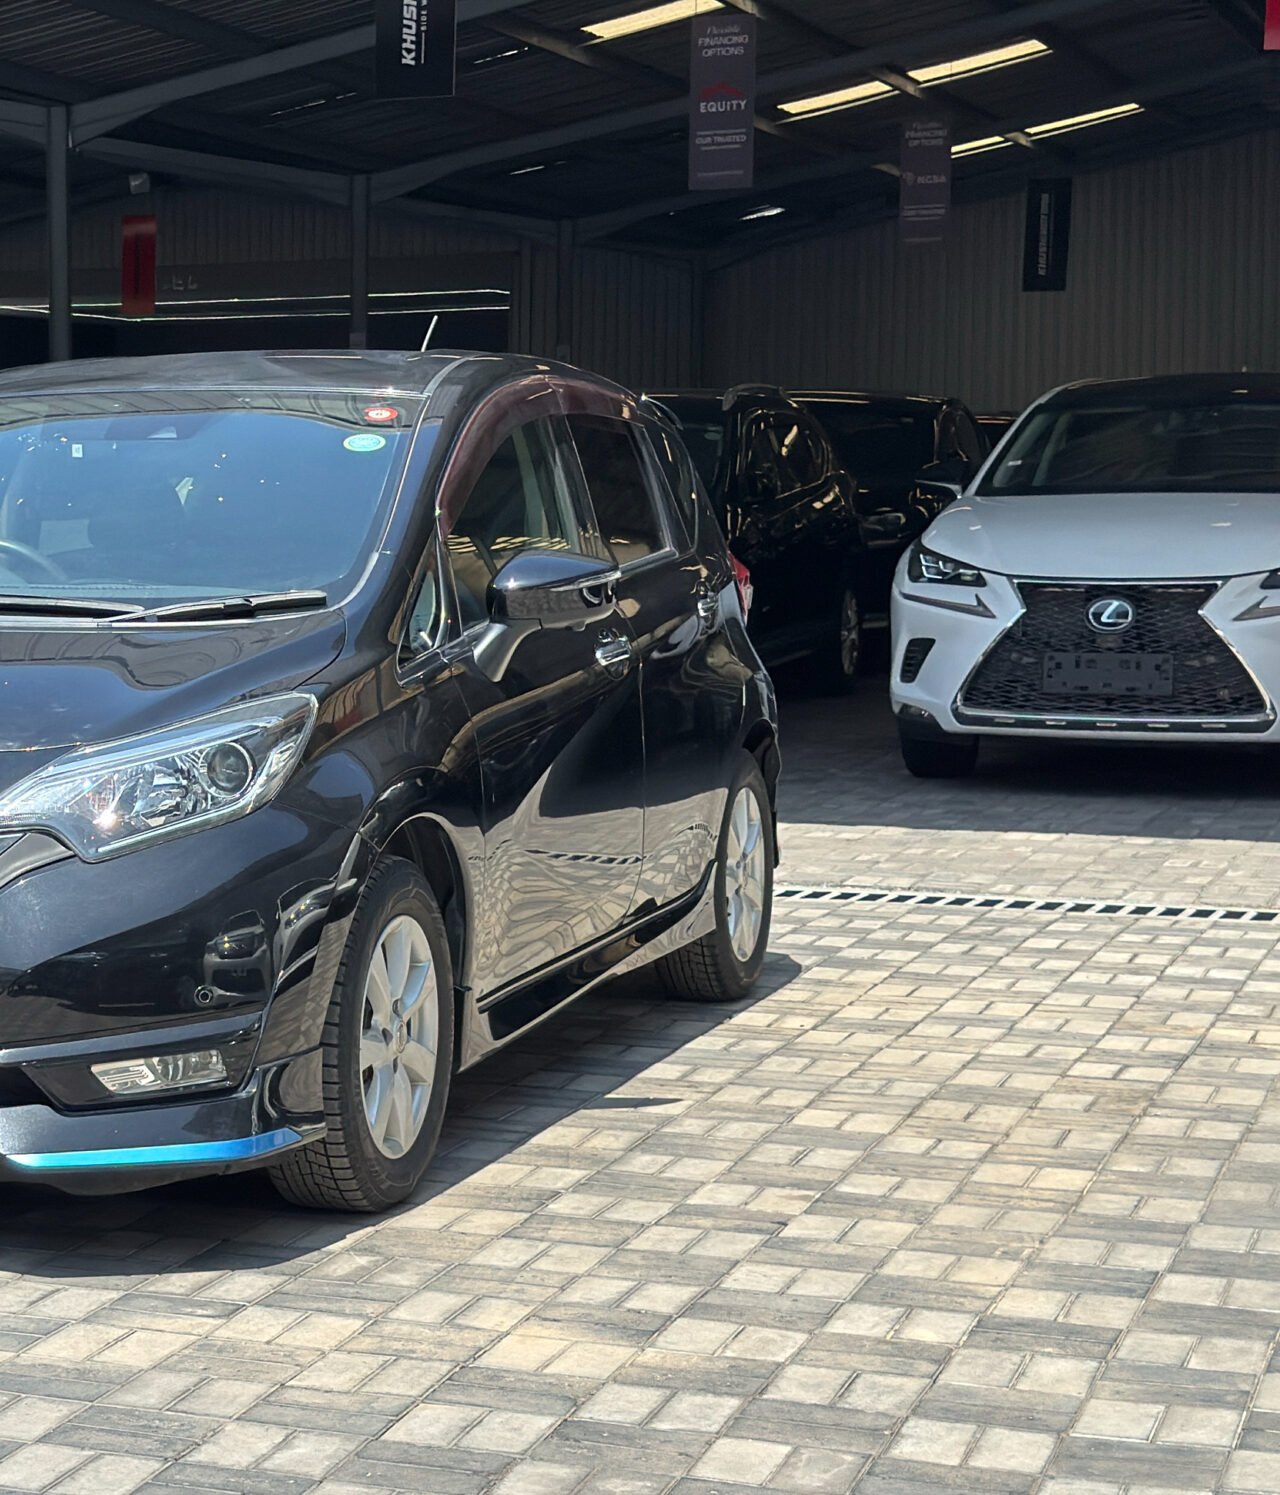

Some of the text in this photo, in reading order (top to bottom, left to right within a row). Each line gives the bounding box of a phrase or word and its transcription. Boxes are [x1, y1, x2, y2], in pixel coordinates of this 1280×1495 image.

[698, 34, 749, 46] FINANCING
[702, 46, 745, 57] OPTIONS
[699, 99, 748, 113] EQUITY
